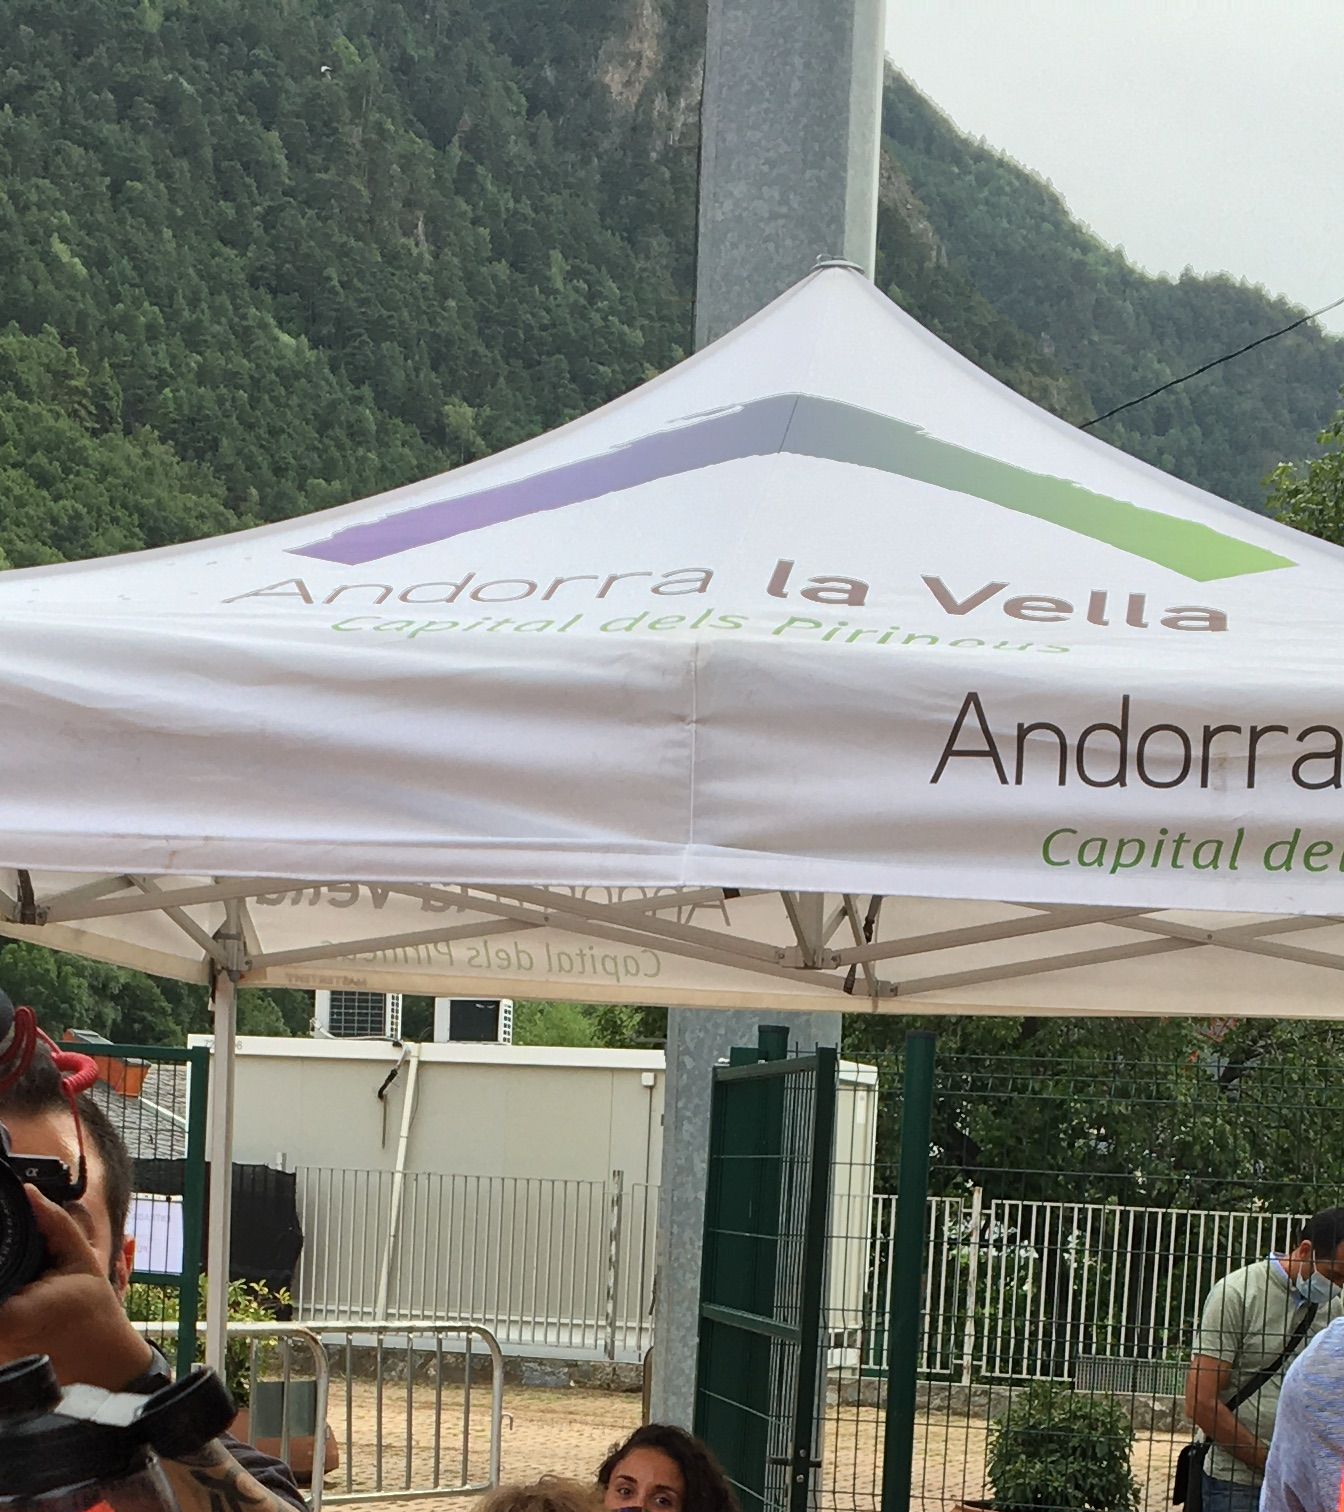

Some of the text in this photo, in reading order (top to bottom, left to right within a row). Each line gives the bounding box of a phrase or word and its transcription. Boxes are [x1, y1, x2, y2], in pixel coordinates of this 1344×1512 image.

[224, 557, 1229, 632] Andorra la Vella
[331, 613, 584, 639] Capital
[599, 607, 750, 631] dels
[929, 691, 1344, 790] Andorra
[1041, 827, 1245, 875] Capital
